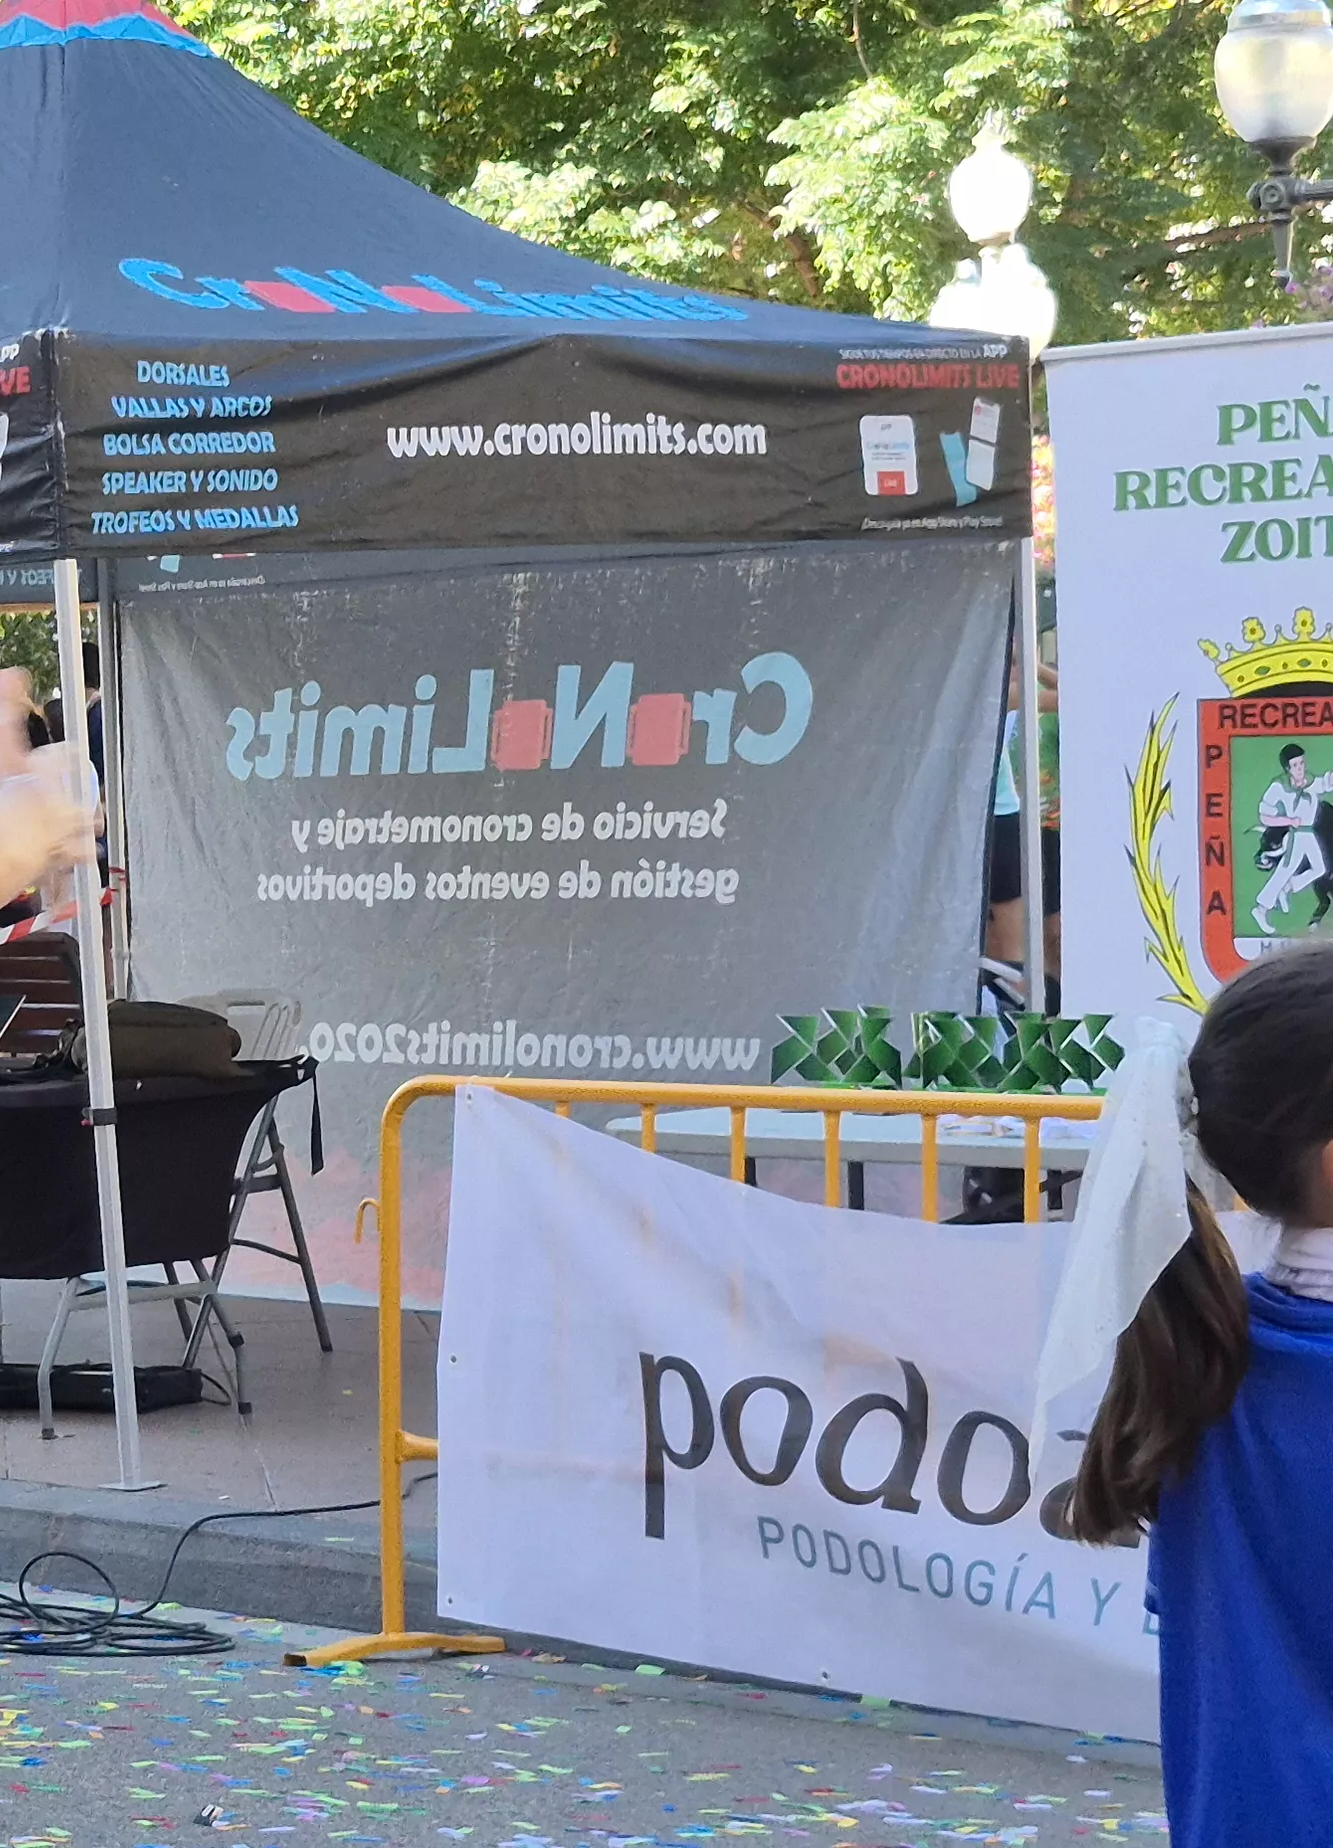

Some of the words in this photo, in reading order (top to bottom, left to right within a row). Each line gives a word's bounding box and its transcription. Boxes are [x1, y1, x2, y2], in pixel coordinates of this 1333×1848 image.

[982, 343, 1008, 358] APP
[137, 360, 230, 387] DORSALES
[836, 362, 972, 389] CRONOLIMITS
[975, 363, 1019, 389] LIVE
[111, 395, 189, 418] VALLAS
[190, 396, 205, 418] Y
[210, 394, 273, 418] ARCOS
[1216, 383, 1333, 446] PEÑ
[103, 433, 166, 456] BOLSA
[168, 431, 276, 455] CORREDOR
[386, 411, 767, 459] www.cronolimits.com
[102, 471, 187, 495] SPEAKER
[189, 470, 204, 492] Y
[206, 468, 278, 493] SONIDO
[1113, 454, 1333, 511] RECREA
[91, 510, 176, 535] TROFEOS
[177, 509, 191, 530] Y
[194, 504, 299, 529] MEDALLAS
[1218, 703, 1333, 729] RECREA
[757, 1516, 1057, 1620] PODOLOGÍA
[1090, 1578, 1123, 1627] Y
